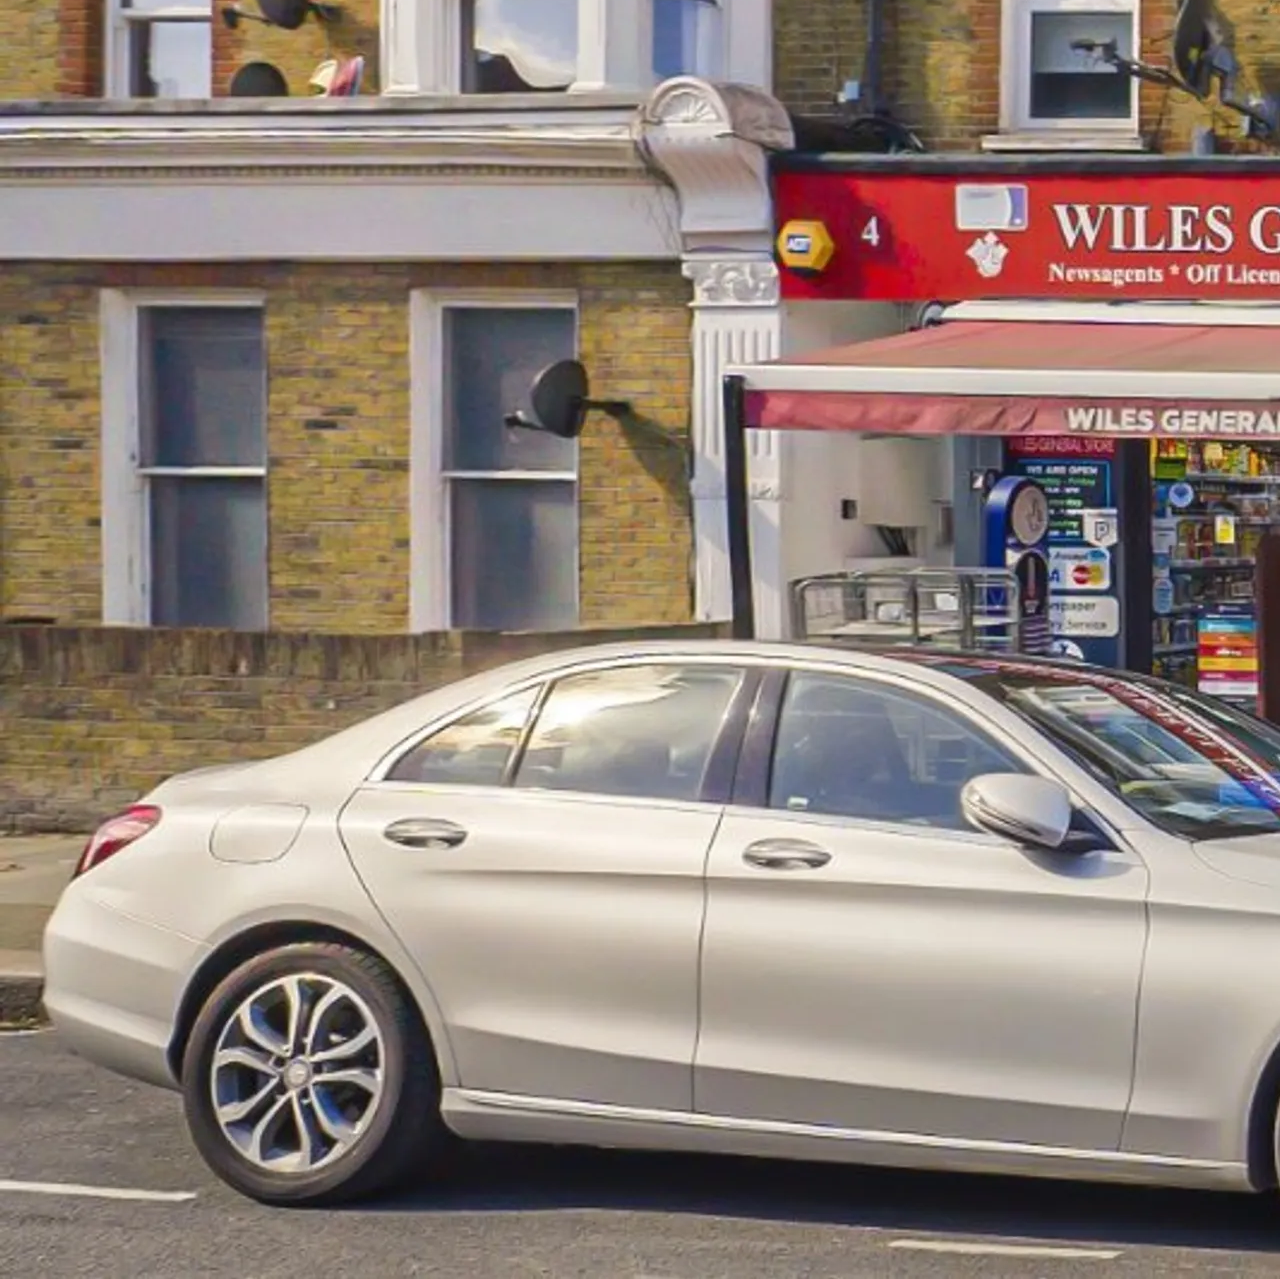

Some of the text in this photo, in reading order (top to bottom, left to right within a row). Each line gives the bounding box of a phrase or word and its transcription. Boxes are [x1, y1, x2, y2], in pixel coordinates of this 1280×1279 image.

[861, 215, 880, 247] 4
[1052, 203, 1235, 254] WILES
[1048, 263, 1164, 286] Newsagents
[1186, 264, 1221, 283] Off
[1067, 407, 1155, 431] WILES
